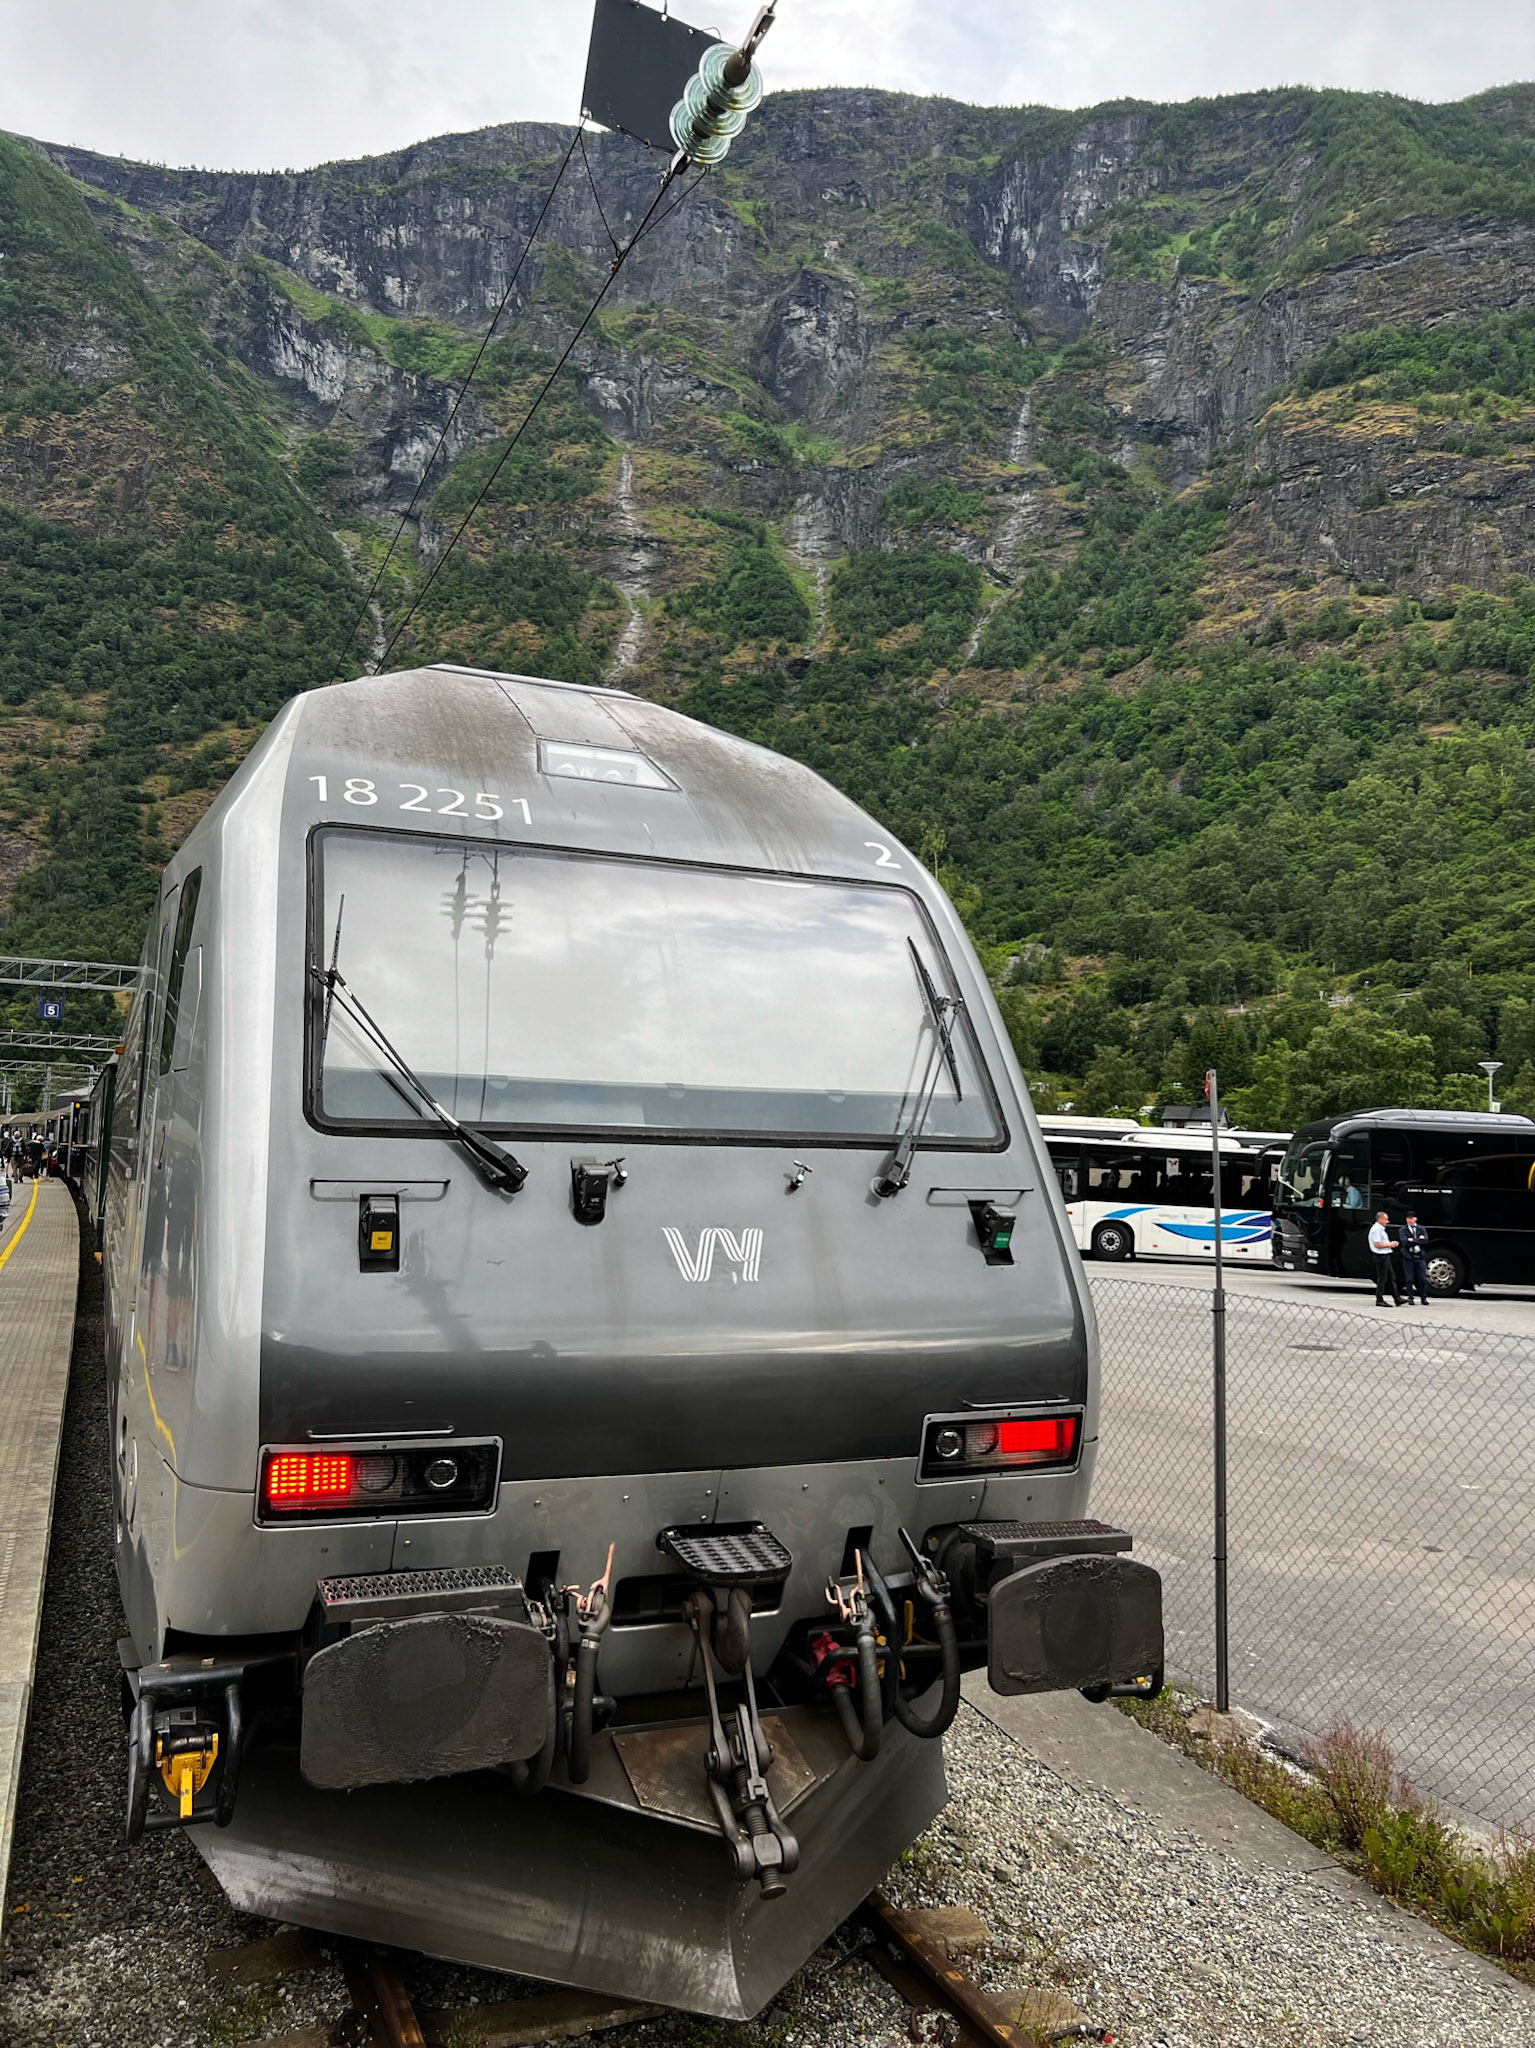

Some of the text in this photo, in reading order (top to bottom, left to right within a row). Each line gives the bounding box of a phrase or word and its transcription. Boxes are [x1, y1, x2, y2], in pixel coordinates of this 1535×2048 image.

[308, 775, 533, 825] 18 2251
[863, 841, 902, 870] 2
[48, 1005, 56, 1015] 5
